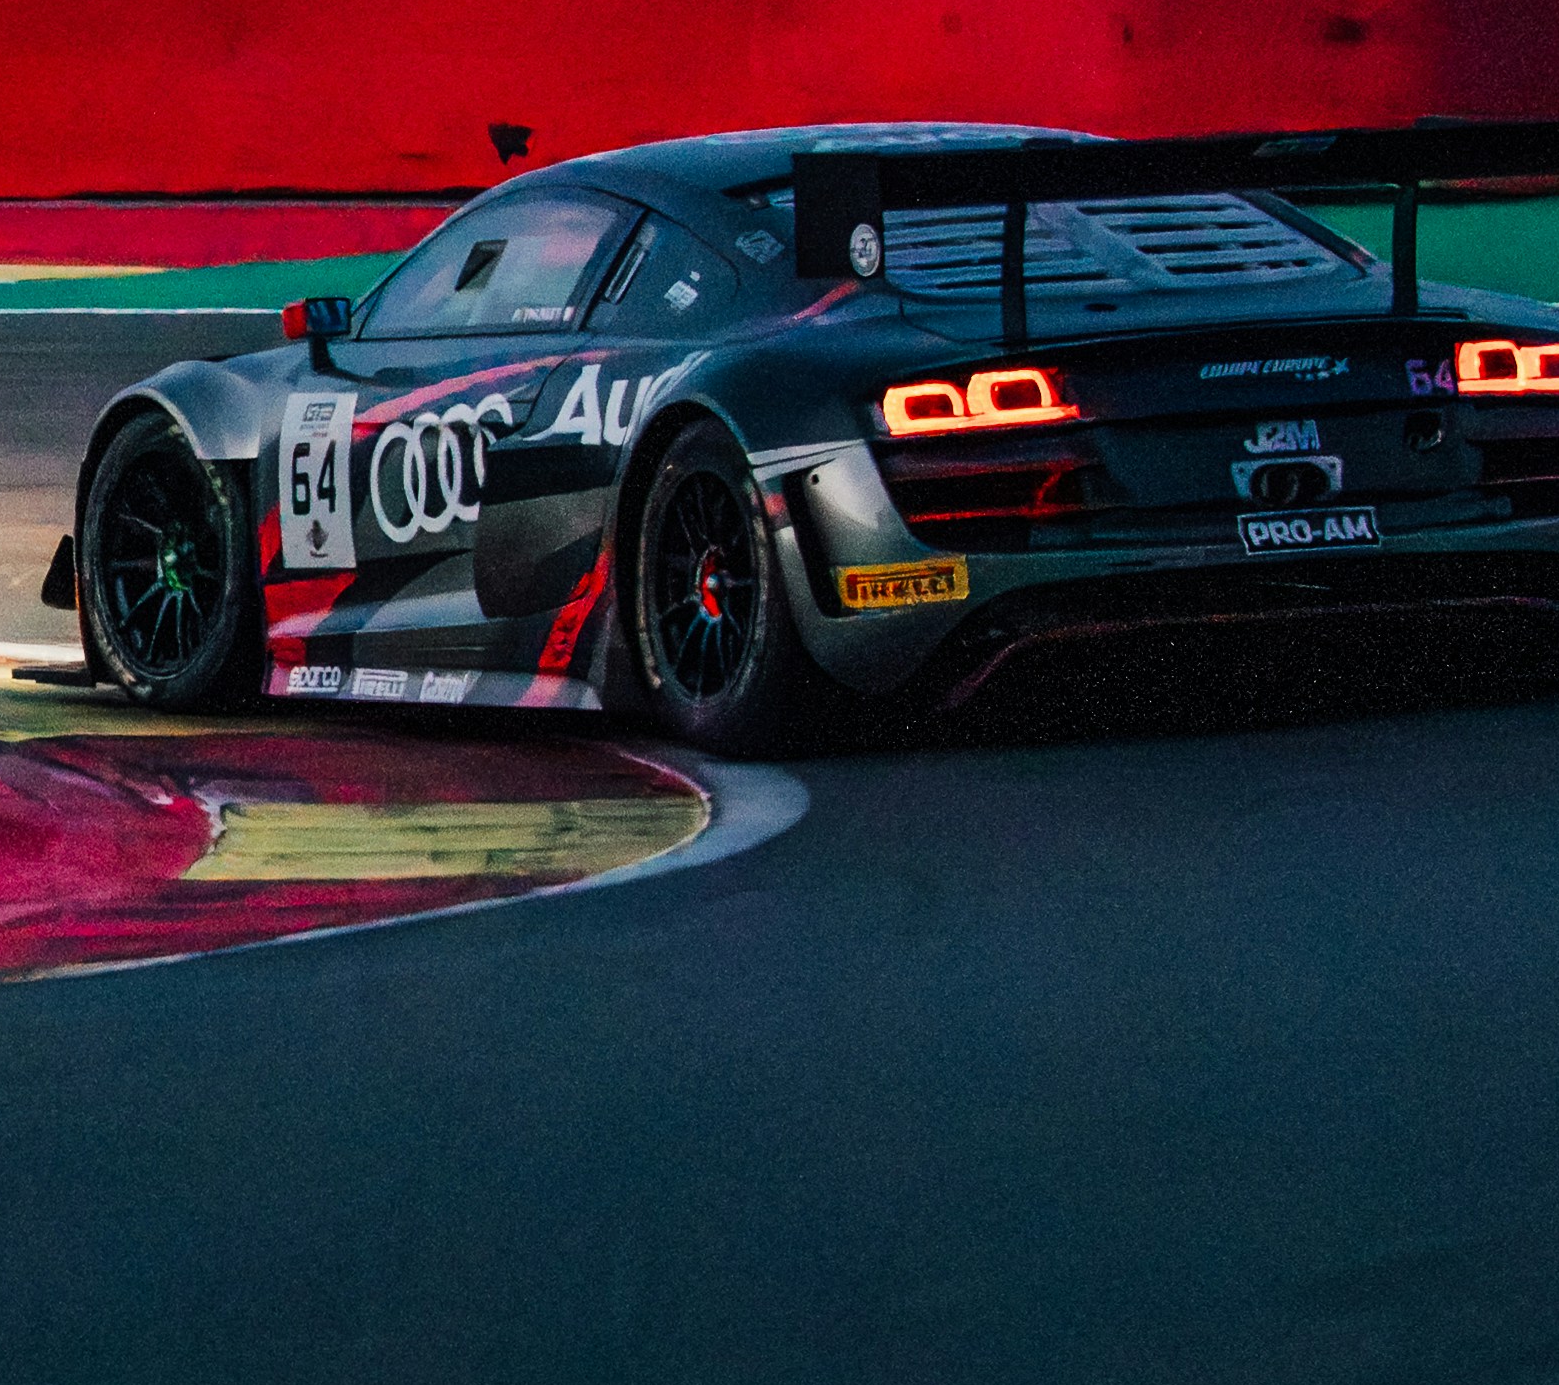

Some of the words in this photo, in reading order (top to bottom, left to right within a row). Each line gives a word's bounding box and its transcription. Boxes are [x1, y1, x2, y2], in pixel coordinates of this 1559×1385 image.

[1405, 359, 1455, 396] 64
[1243, 418, 1321, 454] J2M
[291, 439, 337, 516] 64
[1247, 514, 1373, 547] PRO-AM
